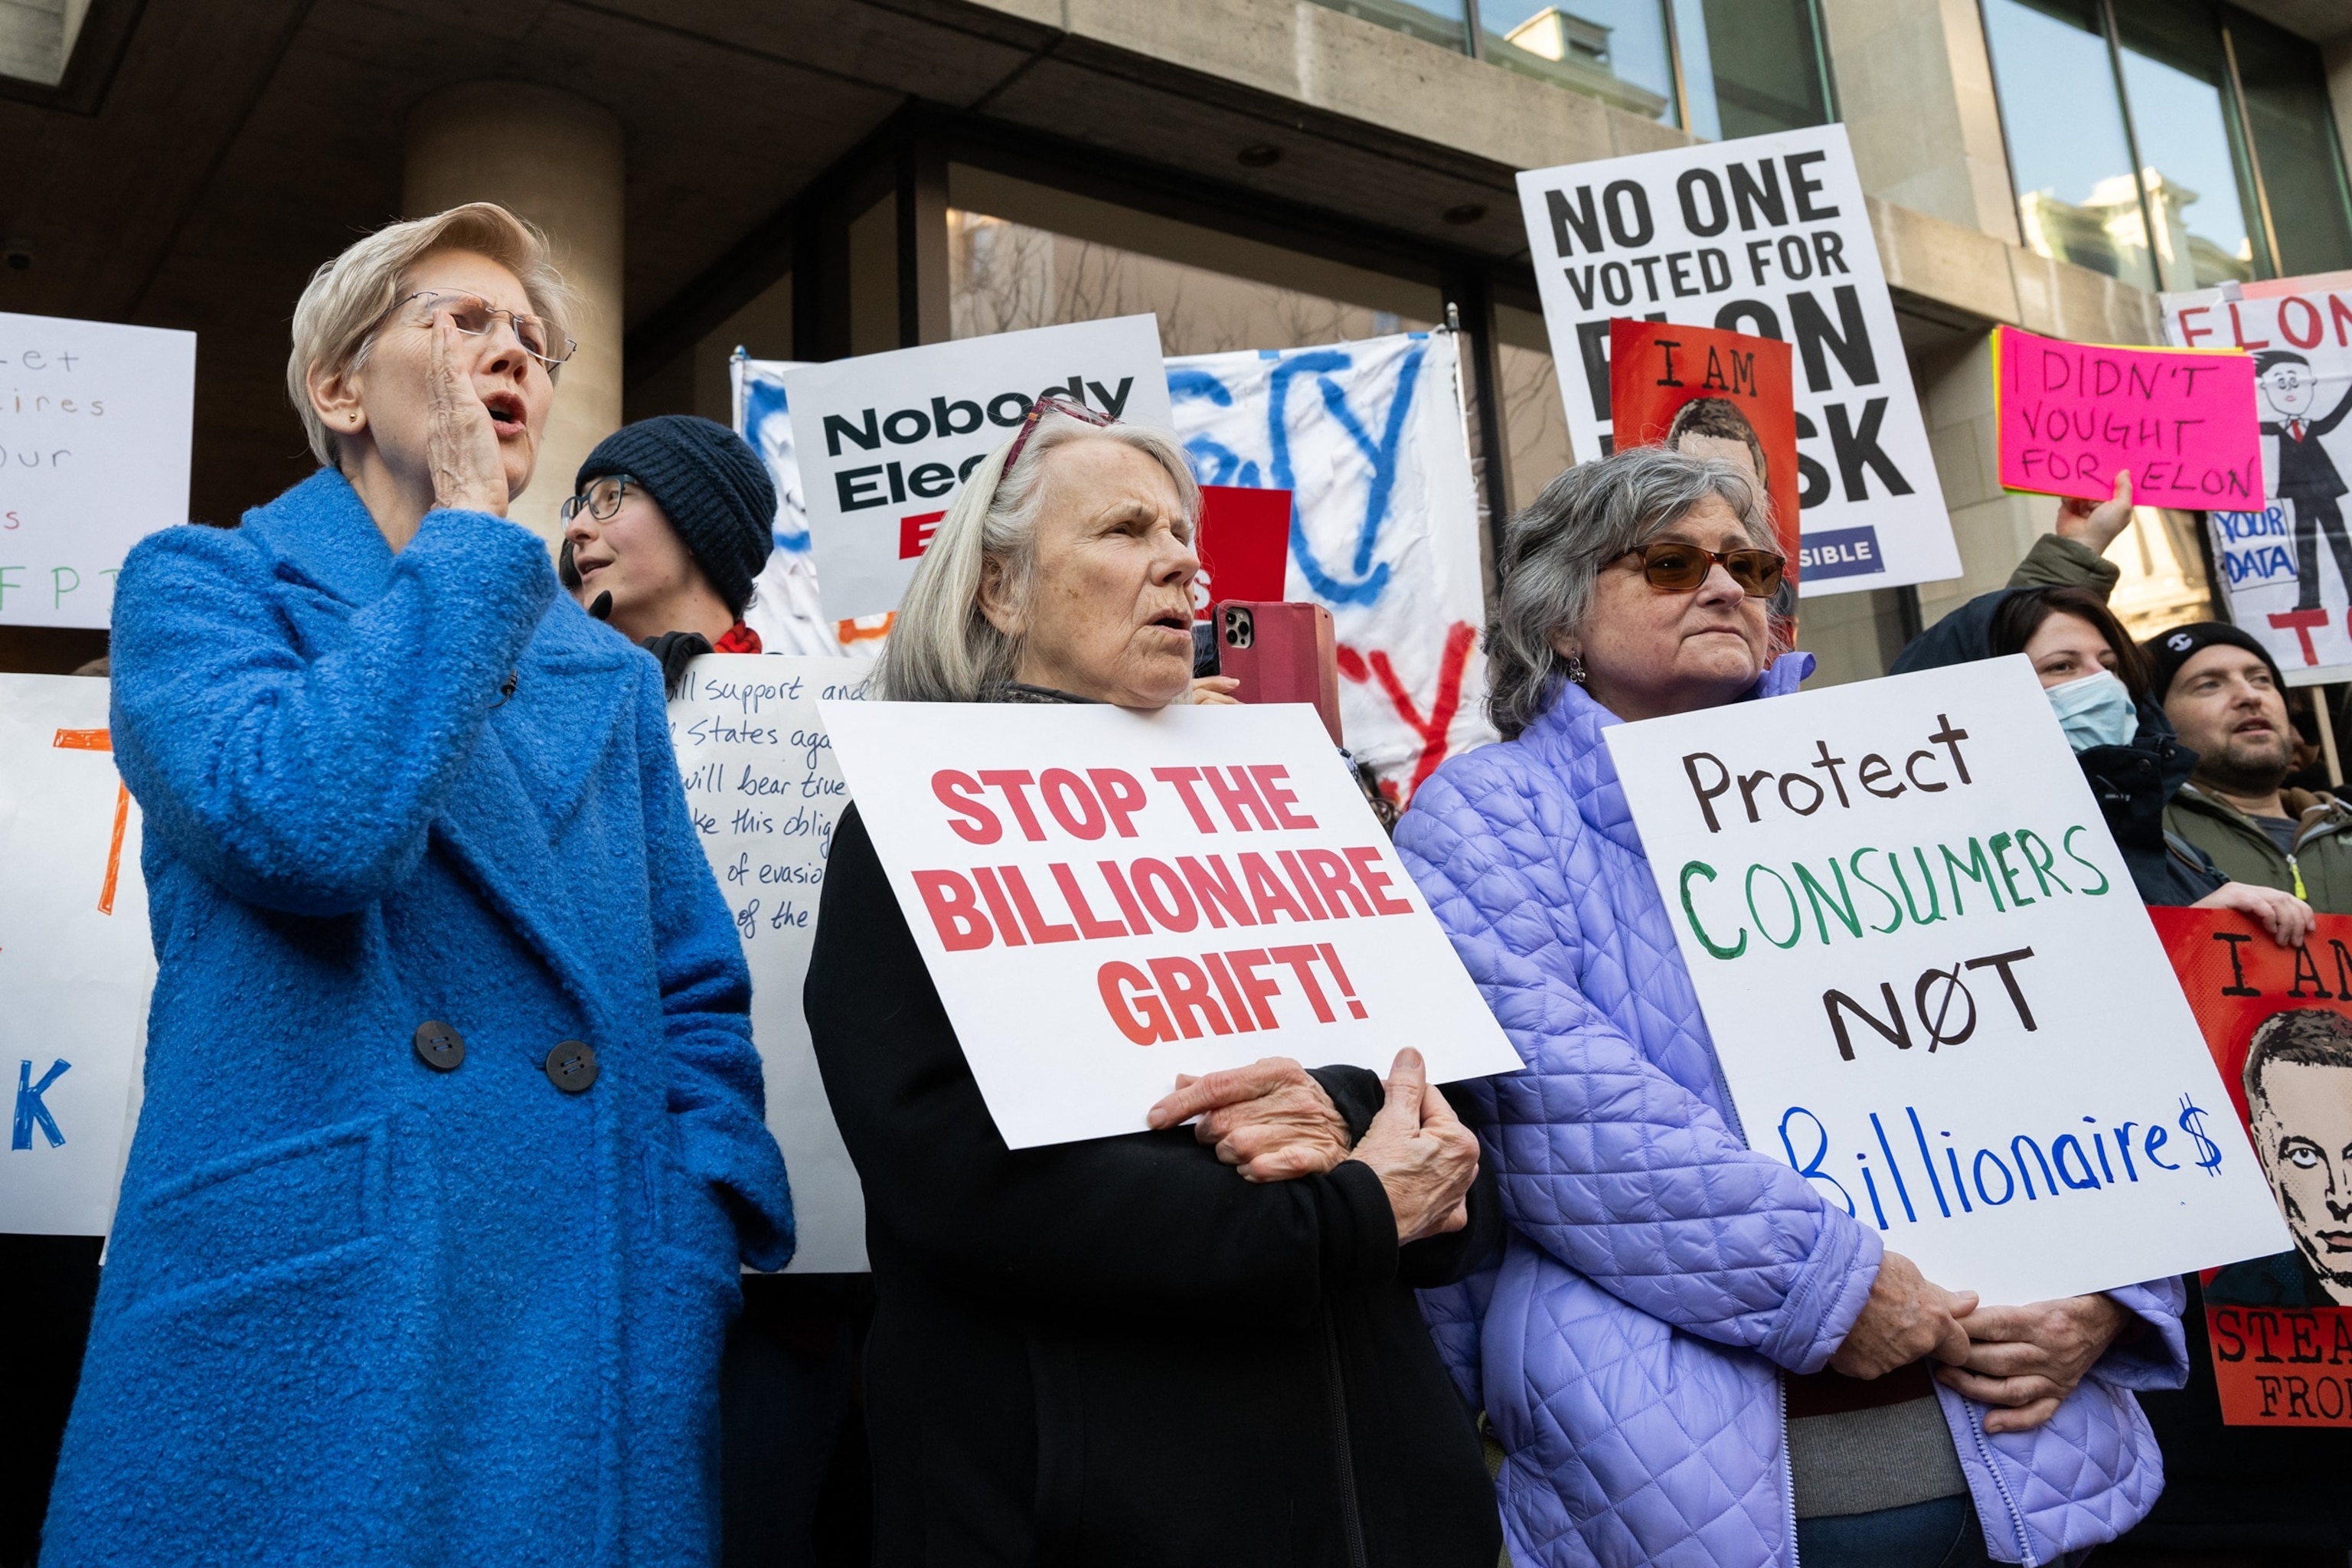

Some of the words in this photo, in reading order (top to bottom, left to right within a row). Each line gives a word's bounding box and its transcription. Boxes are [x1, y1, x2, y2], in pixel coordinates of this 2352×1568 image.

[1544, 178, 1655, 258] NO
[1676, 150, 1841, 237] ONE
[1564, 247, 1733, 312] VOTED
[1746, 230, 1851, 286] FOR
[0, 350, 79, 372] et
[1654, 339, 1684, 387] I
[1701, 345, 1758, 398] AM
[2043, 349, 2219, 400] DIDN'T
[0, 387, 104, 416] ires
[2023, 400, 2205, 456] VOUGHT
[2022, 449, 2113, 489] FOR
[2141, 456, 2256, 498] ELON
[2213, 506, 2285, 544] YOUR
[2224, 545, 2297, 583] DATA
[705, 676, 804, 714] support
[688, 715, 779, 746] States
[737, 764, 791, 796] bear
[801, 772, 847, 798] true
[1682, 714, 1972, 833] Protect
[731, 808, 773, 835] this
[930, 767, 1148, 846] STOP
[1150, 764, 1319, 835] THE
[728, 852, 750, 886] of
[1679, 825, 2109, 960] CONSUMERS
[771, 900, 808, 929] the
[910, 846, 1415, 952] BILLIONAIRE
[2213, 932, 2261, 997] I
[1097, 942, 1369, 1046] GRIFT!
[2255, 1376, 2352, 1419] FRO
